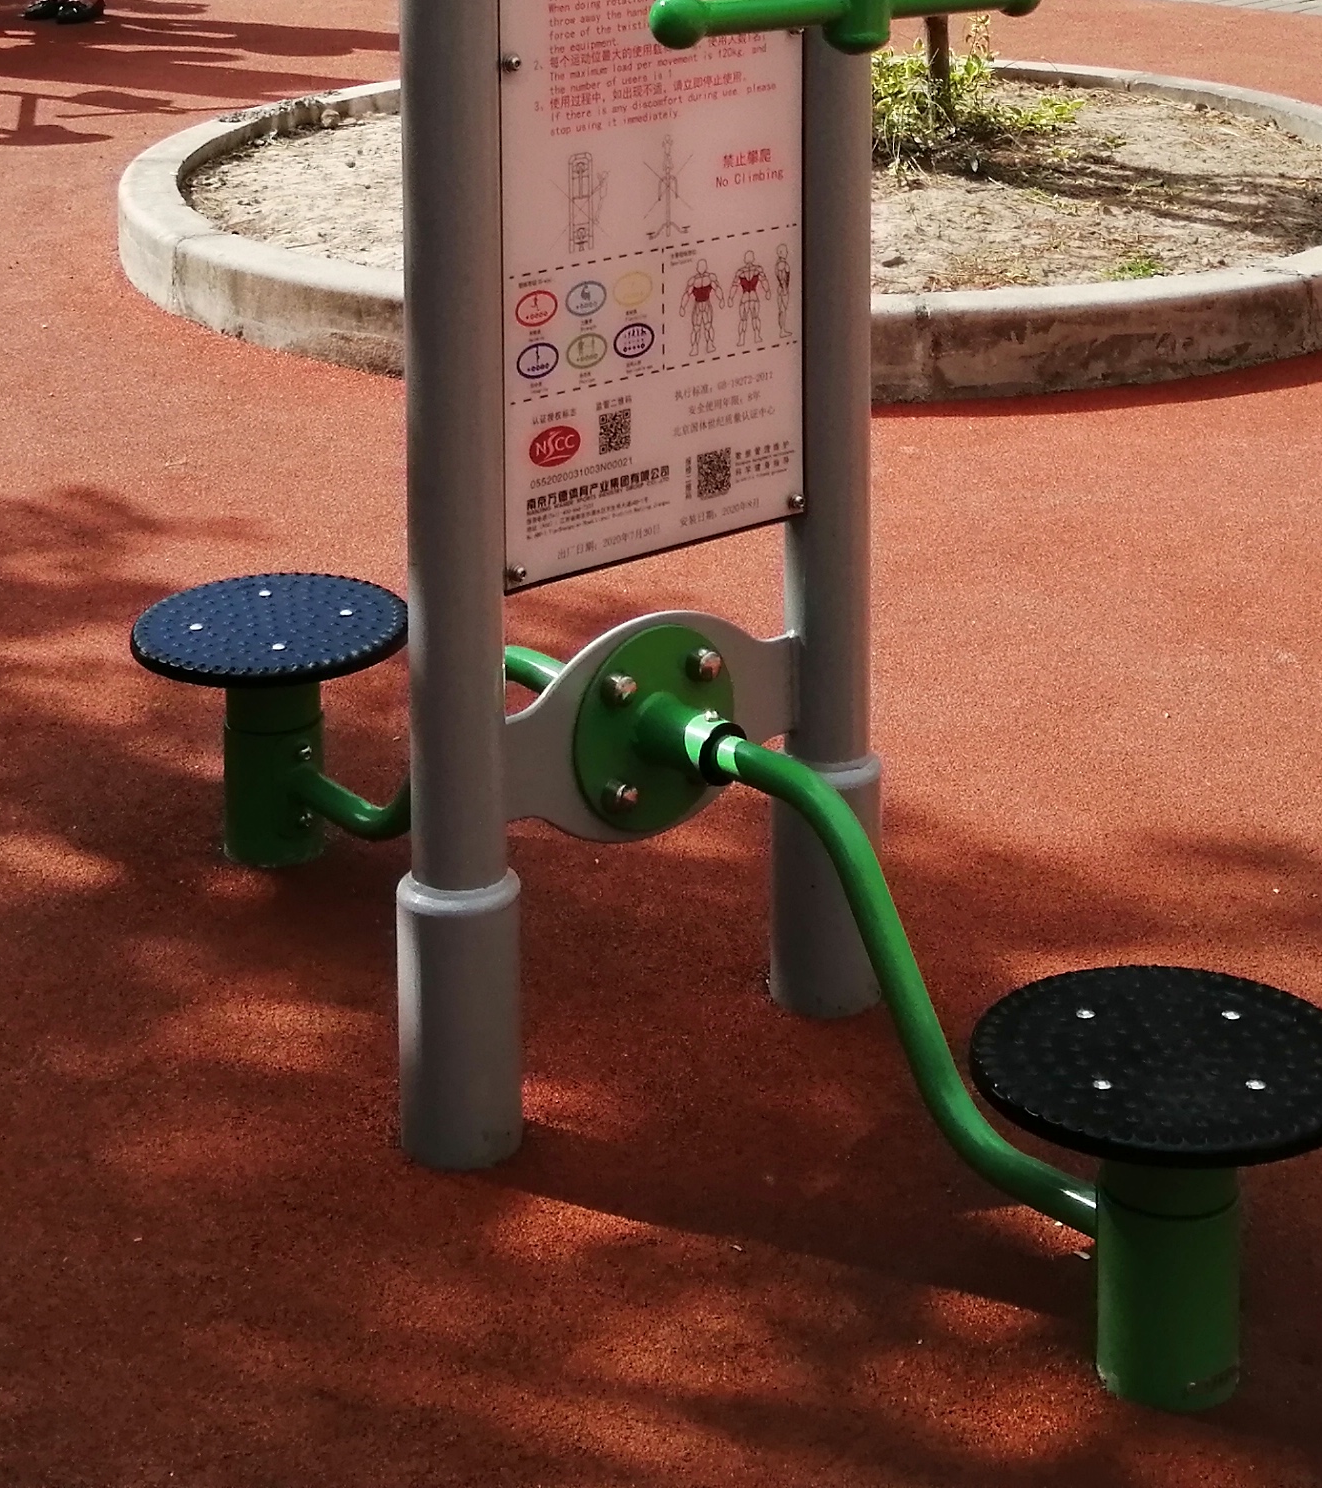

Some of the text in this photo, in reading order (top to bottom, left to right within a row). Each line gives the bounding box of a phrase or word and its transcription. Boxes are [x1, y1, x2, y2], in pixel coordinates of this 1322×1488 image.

[548, 3, 571, 14] When
[574, 0, 601, 11] doing
[549, 17, 576, 28] throw
[580, 14, 601, 24] away
[607, 10, 622, 20] the
[549, 21, 650, 41] force of the twisti
[549, 45, 565, 55] the
[550, 72, 565, 82] The
[570, 67, 608, 80] maximum
[612, 63, 633, 73] load
[637, 61, 652, 71] per
[657, 54, 698, 66] movement
[703, 51, 713, 61] is
[752, 43, 767, 54] and
[549, 85, 566, 95] the
[570, 81, 601, 92] number
[606, 77, 617, 88] of
[621, 74, 648, 85] users
[653, 71, 663, 81] is
[551, 112, 560, 122] If
[565, 109, 591, 121] there
[597, 107, 607, 116] is
[612, 104, 627, 114] any
[632, 95, 683, 111] discomfort
[687, 91, 718, 103] during
[746, 82, 777, 95] please
[550, 127, 572, 137] stop
[575, 121, 602, 132] using
[608, 117, 617, 127] it
[723, 148, 771, 168] 禁止攀爬
[716, 169, 784, 188] No Climbing
[532, 407, 577, 425] 认证授权标志
[535, 431, 575, 458] NSCC
[527, 465, 670, 510] 南京万德体育产业集团有限公司
